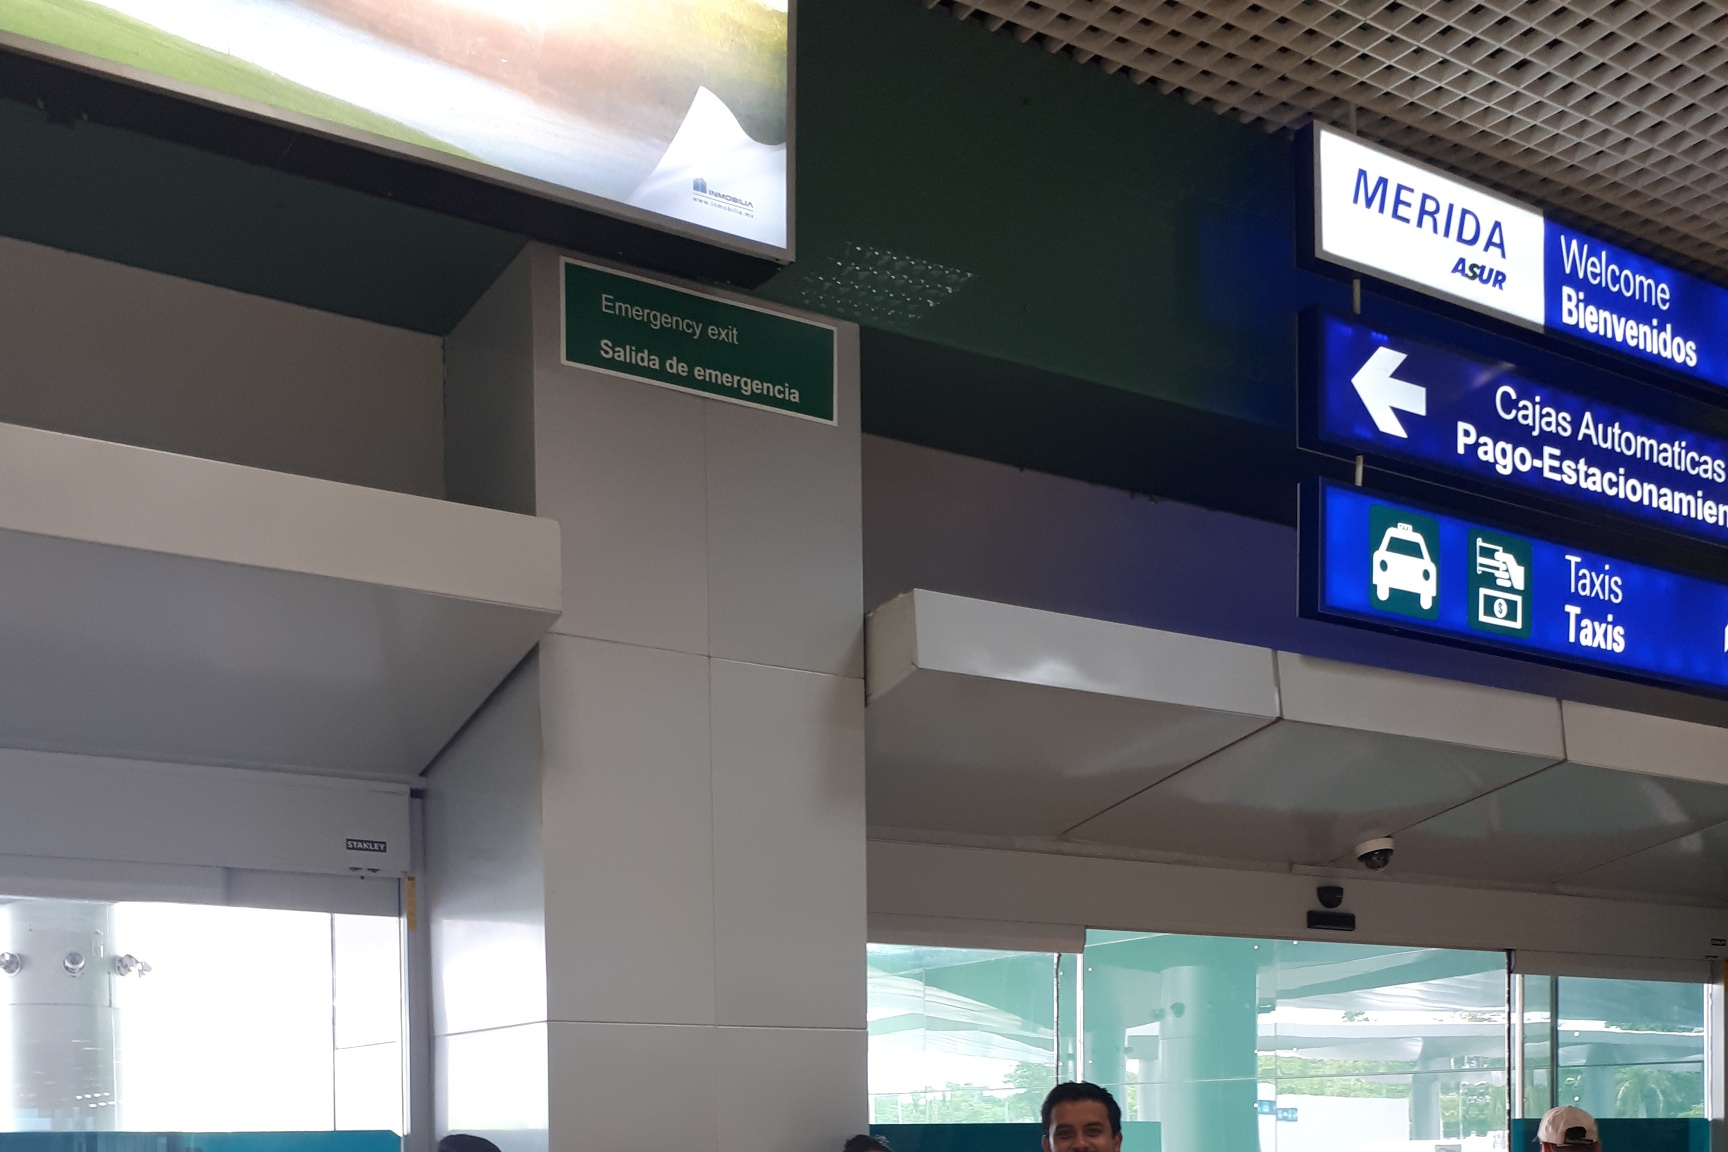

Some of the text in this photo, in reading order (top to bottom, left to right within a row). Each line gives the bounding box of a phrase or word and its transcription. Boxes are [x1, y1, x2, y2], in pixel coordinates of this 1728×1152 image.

[708, 189, 754, 208] INMOBILIA
[1352, 167, 1507, 260] MERIDA
[1451, 257, 1507, 291] ASUR
[1560, 234, 1671, 311] Welcome
[601, 293, 739, 345] Emergency exit
[1561, 285, 1698, 368] Bienvenidos
[600, 339, 800, 404] Salida de emergencia
[1495, 385, 1726, 483] Cajas Automaticas
[1564, 554, 1624, 604] Taxis
[1564, 604, 1626, 653] Taxis
[347, 841, 386, 851] STANLEY
